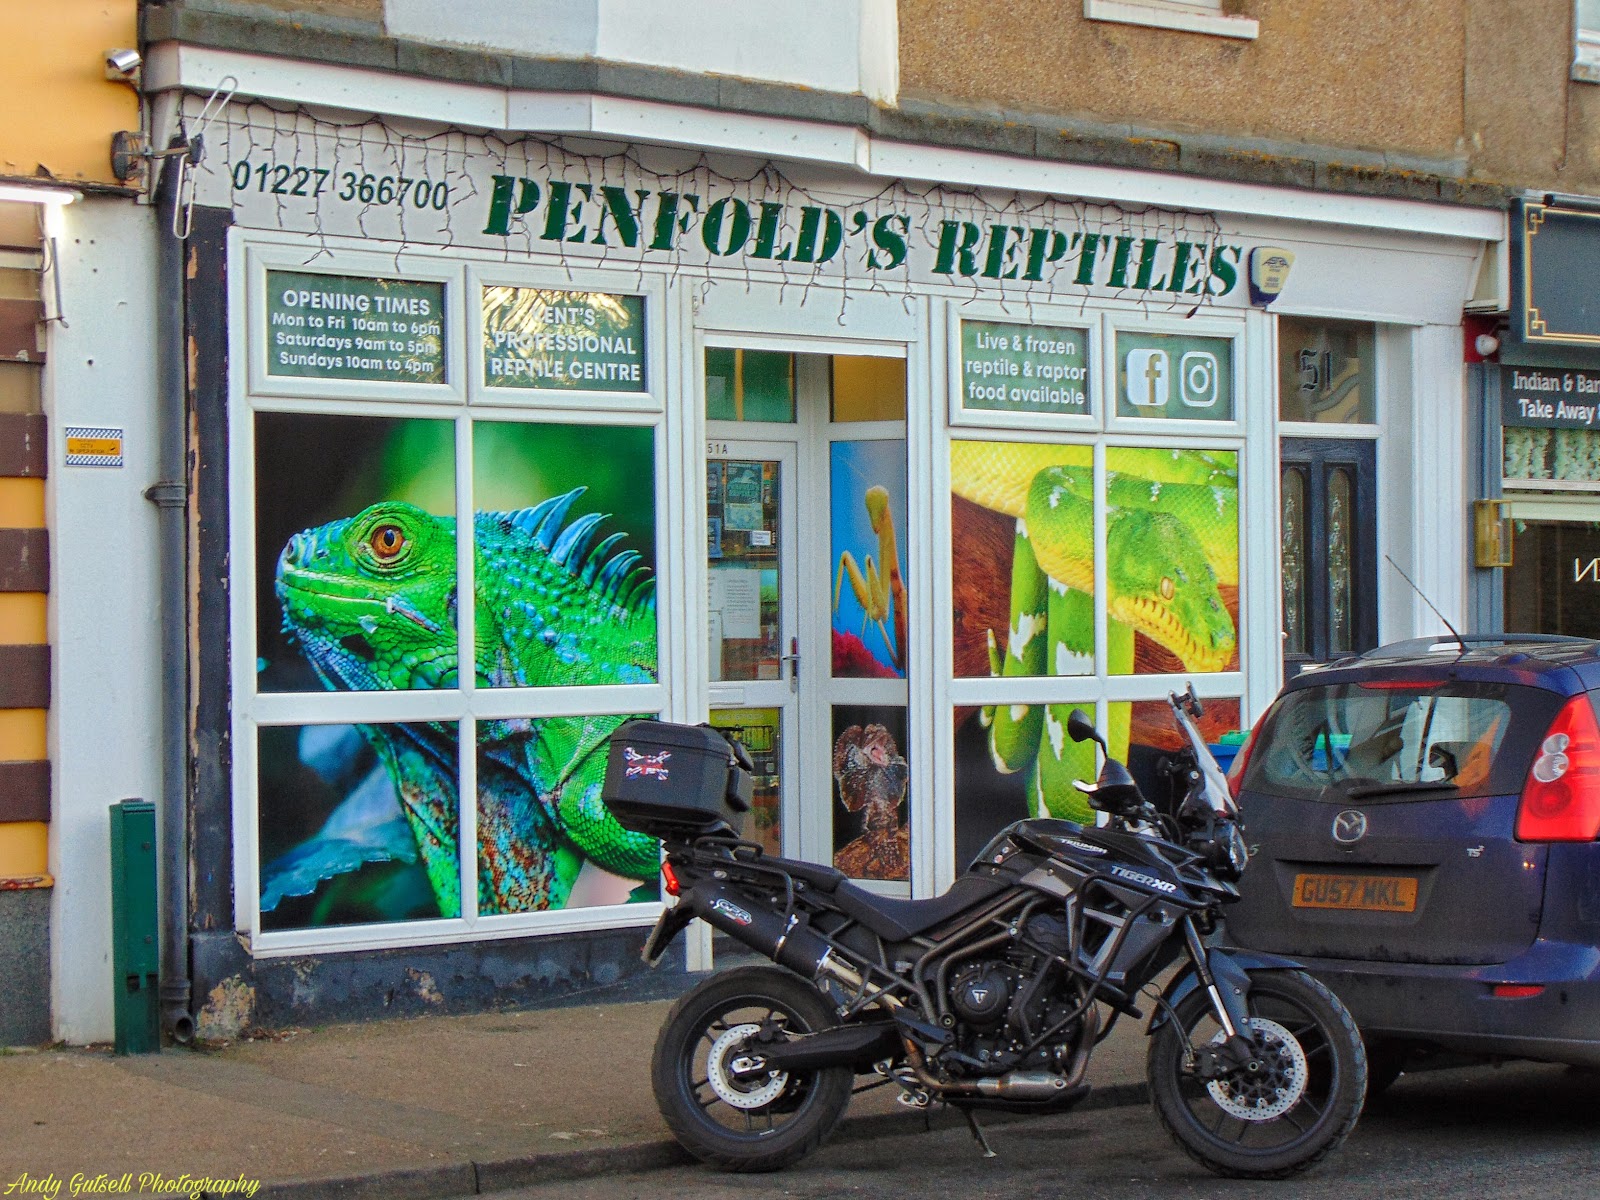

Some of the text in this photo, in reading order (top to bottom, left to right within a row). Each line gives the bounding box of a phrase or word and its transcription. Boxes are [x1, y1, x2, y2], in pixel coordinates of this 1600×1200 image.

[233, 160, 449, 211] 01227 366700
[482, 174, 1243, 298] PENFOLD'S REPTILES
[283, 290, 431, 316] OPENING TIMES
[272, 313, 441, 337] Mon to Fri 10am to 6pm
[276, 332, 438, 356] Saturdays 9am to 5pm
[494, 330, 637, 354] PROFESSIONAL
[976, 332, 1076, 355] Live & frozen
[280, 351, 435, 375] Sundays 10am to 4pm
[491, 357, 641, 381] REPTILE CENTRE
[966, 358, 1087, 383] reptile & raptor
[969, 381, 1085, 405] food available
[1513, 370, 1560, 391] Indian
[1563, 373, 1574, 393] &
[1518, 398, 1596, 425] Take Away
[1061, 838, 1108, 854] TRIUMPH
